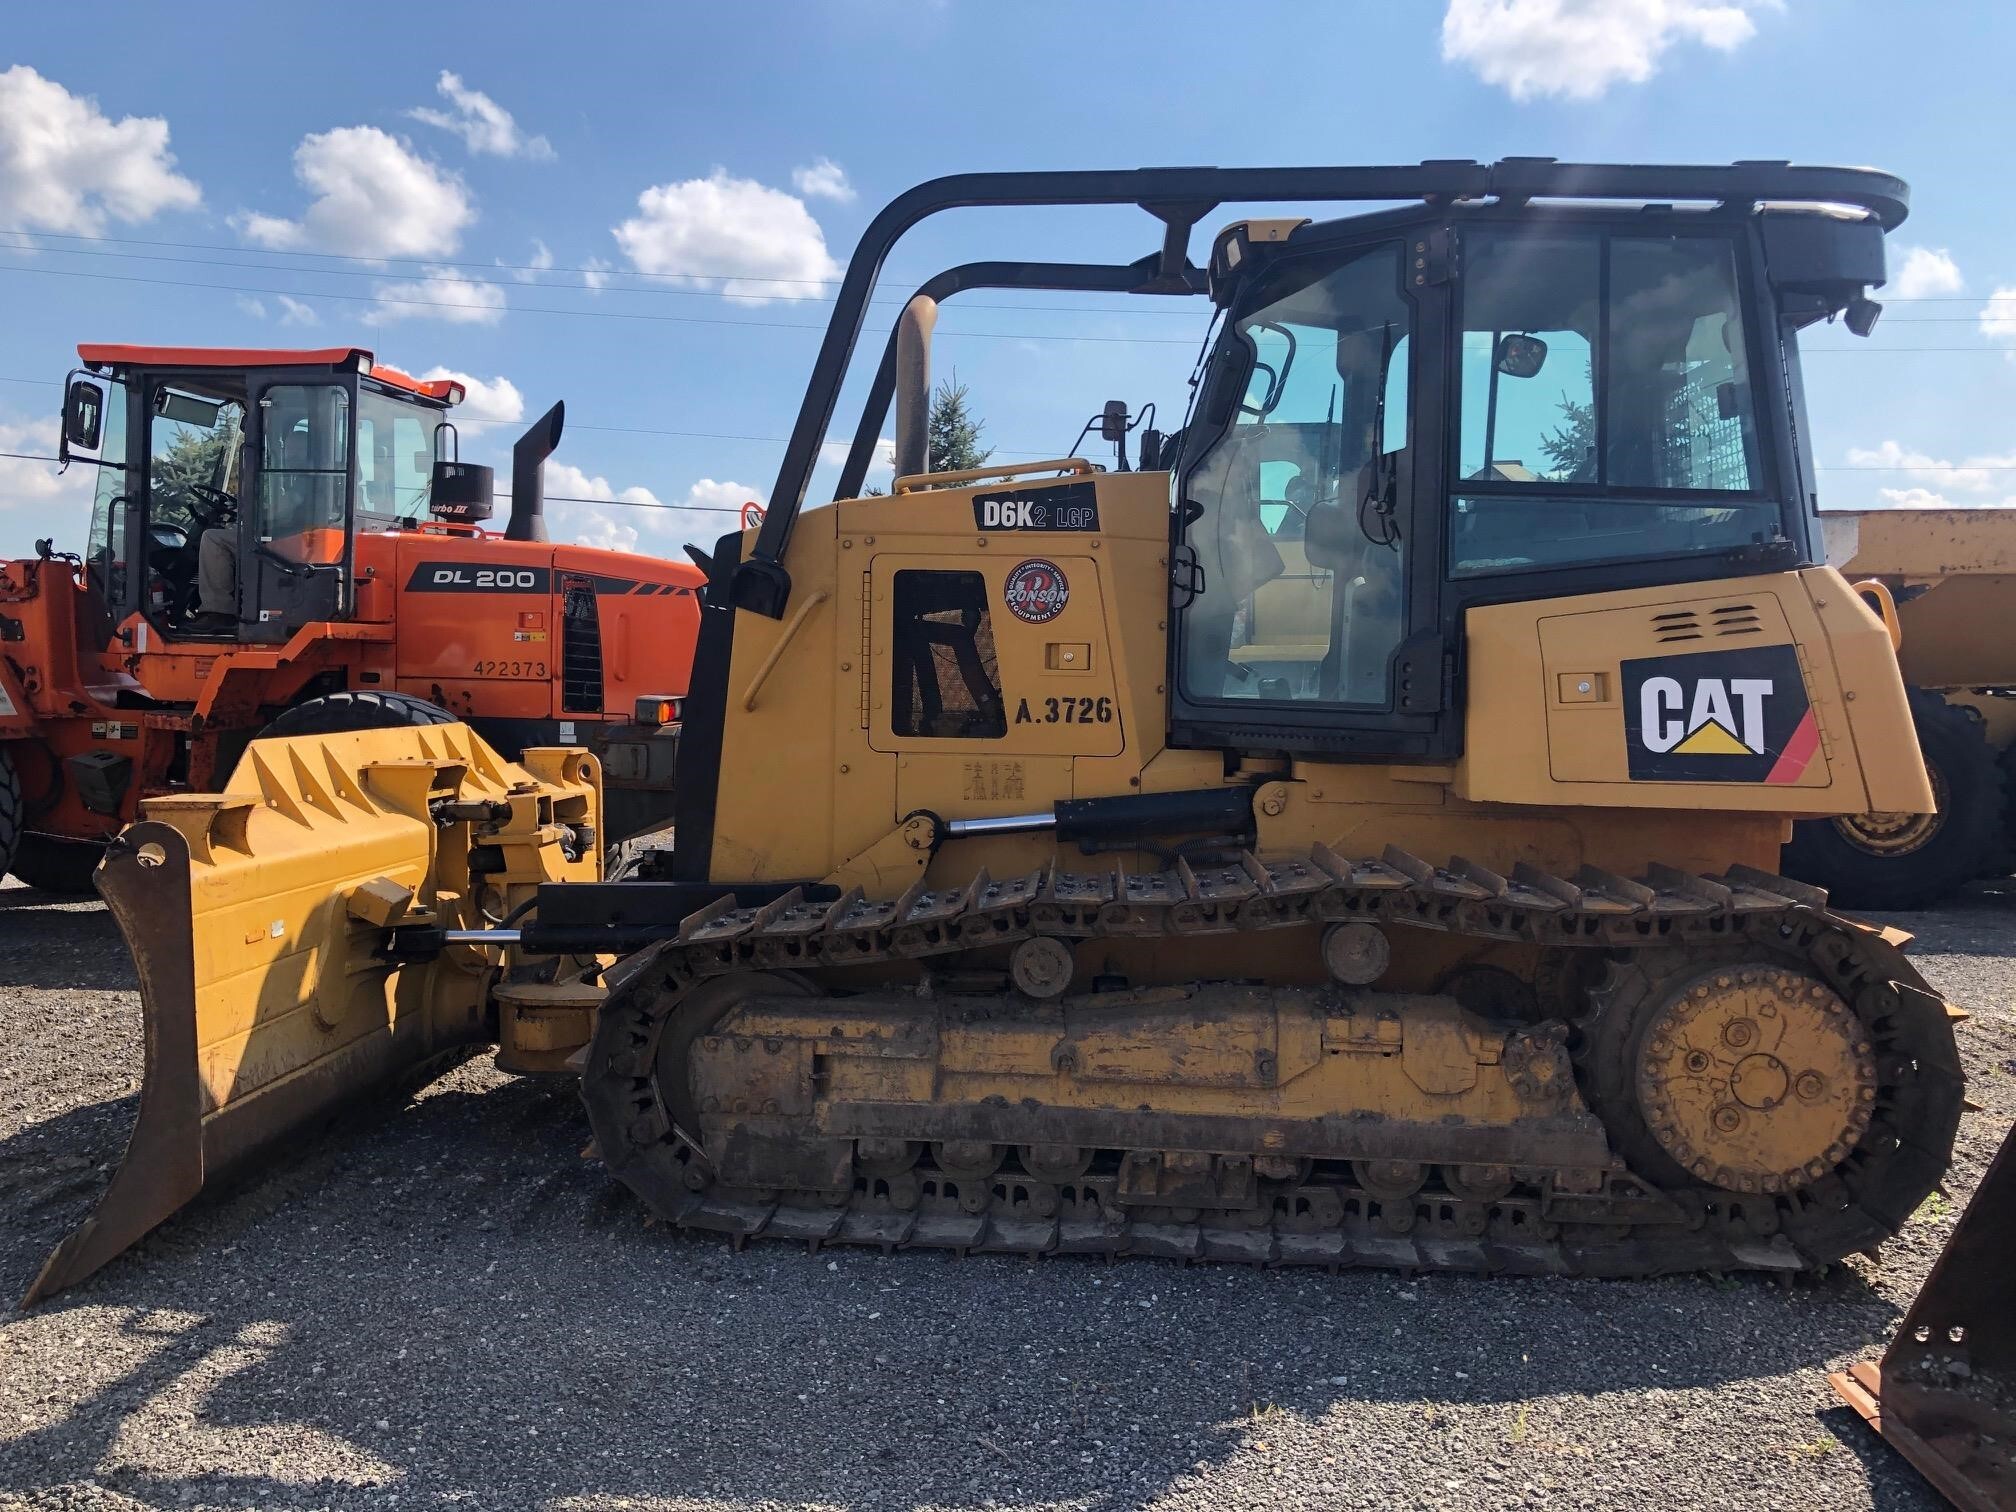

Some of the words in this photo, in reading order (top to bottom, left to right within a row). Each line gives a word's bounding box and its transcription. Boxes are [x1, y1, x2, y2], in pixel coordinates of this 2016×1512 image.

[431, 504, 453, 513] turbo
[984, 501, 1046, 527] D6K2
[1056, 507, 1094, 528] LGP
[433, 571, 471, 583] DL
[476, 571, 535, 587] 200
[1009, 569, 1022, 590] QUALITY
[1024, 563, 1051, 571] INTEGRITY
[1053, 571, 1065, 590] SERVICE
[1006, 589, 1069, 602] RONSON
[1010, 601, 1051, 621] EQUIPMENT
[473, 661, 546, 677] 422373
[1015, 697, 1112, 724] A.3726
[1641, 676, 1773, 754] CAT
